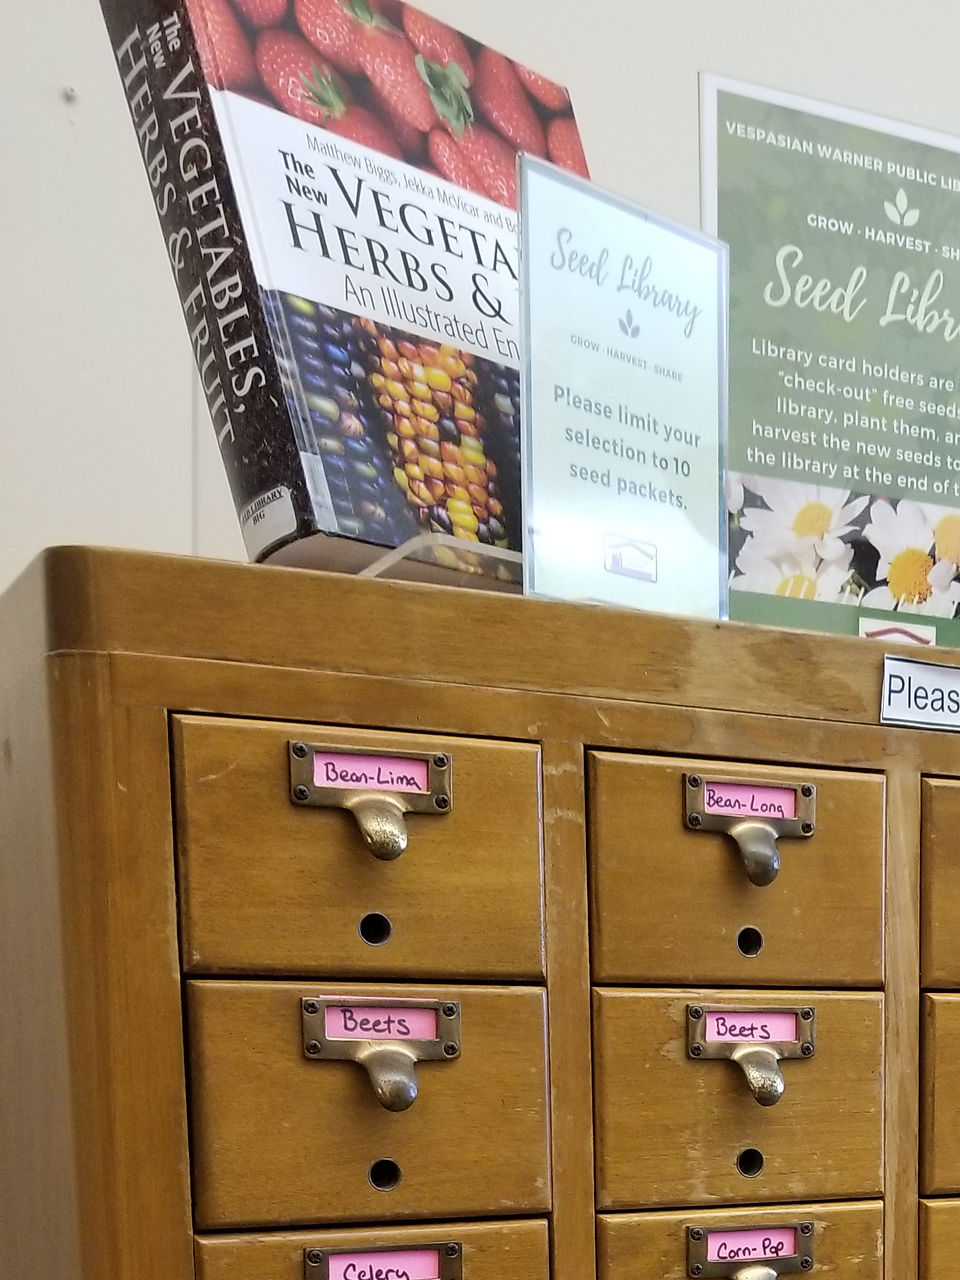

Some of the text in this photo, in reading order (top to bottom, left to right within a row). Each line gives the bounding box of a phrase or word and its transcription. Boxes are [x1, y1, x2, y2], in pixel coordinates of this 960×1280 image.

[146, 23, 165, 69] New
[162, 11, 182, 52] The
[279, 150, 315, 179] The
[726, 122, 813, 154] VESPASIAN
[818, 144, 882, 172] WARNER
[887, 162, 937, 186] PUBLIC
[286, 175, 328, 206] New
[307, 134, 361, 168] Matthew
[404, 173, 435, 198] Jekka
[483, 211, 502, 225] and
[116, 24, 235, 443] HERBS & FRUIT
[807, 214, 853, 235] GROW
[865, 227, 931, 253] HARVEST
[280, 199, 513, 326] HERBS &
[551, 228, 702, 338] Seed Library
[763, 244, 867, 322] Seed
[345, 275, 375, 310] An
[381, 287, 488, 349] Illustrated
[752, 338, 812, 366] Library
[818, 352, 856, 372] card
[862, 361, 924, 386] holders
[929, 376, 955, 391] are
[554, 385, 701, 448] Please limit your
[777, 397, 838, 425] library,
[843, 411, 887, 434] plant
[892, 421, 940, 444] them,
[882, 390, 914, 409] free
[565, 426, 690, 477] selection to 10
[752, 421, 817, 446] harvest
[823, 433, 850, 451] the
[856, 441, 891, 458] new
[896, 448, 941, 468] seeds
[570, 463, 687, 510] seed packets.
[747, 448, 775, 465] the
[782, 453, 837, 478] library
[842, 464, 859, 479] at
[865, 466, 892, 485] the
[898, 475, 928, 492] end
[934, 479, 950, 494] of
[323, 761, 422, 790] Bean-Lima
[705, 788, 784, 817] Bean-Long
[341, 1009, 412, 1036] Beets
[715, 1017, 771, 1039] Beets
[717, 1237, 784, 1260] Corn-Pop
